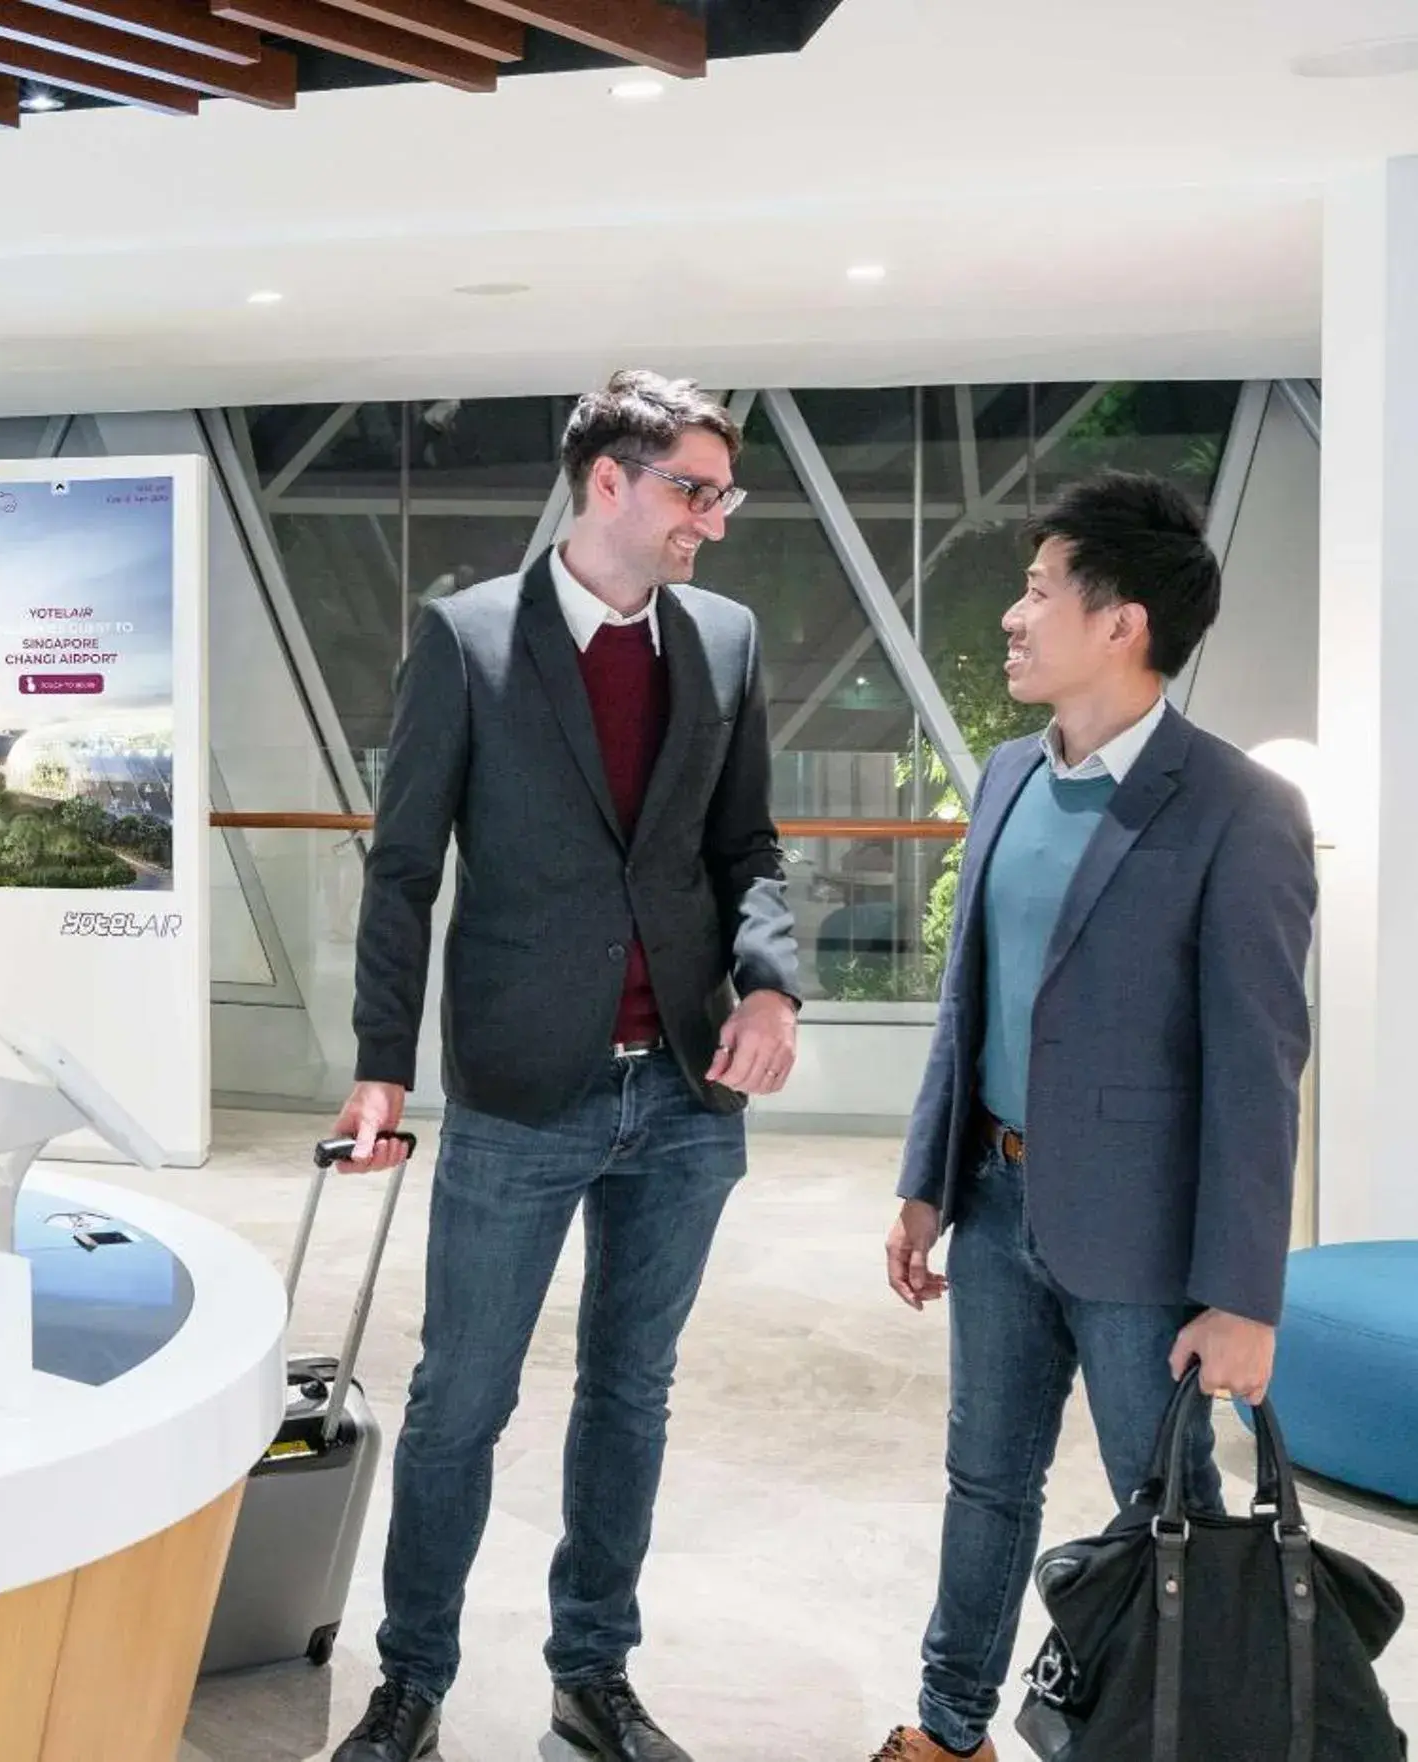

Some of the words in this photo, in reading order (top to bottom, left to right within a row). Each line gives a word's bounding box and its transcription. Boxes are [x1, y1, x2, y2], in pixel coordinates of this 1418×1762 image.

[29, 607, 93, 619] YOTELAIR
[22, 638, 100, 650] SINGAPORE
[5, 654, 56, 664] CHANGI
[60, 654, 118, 664] AIRPORT
